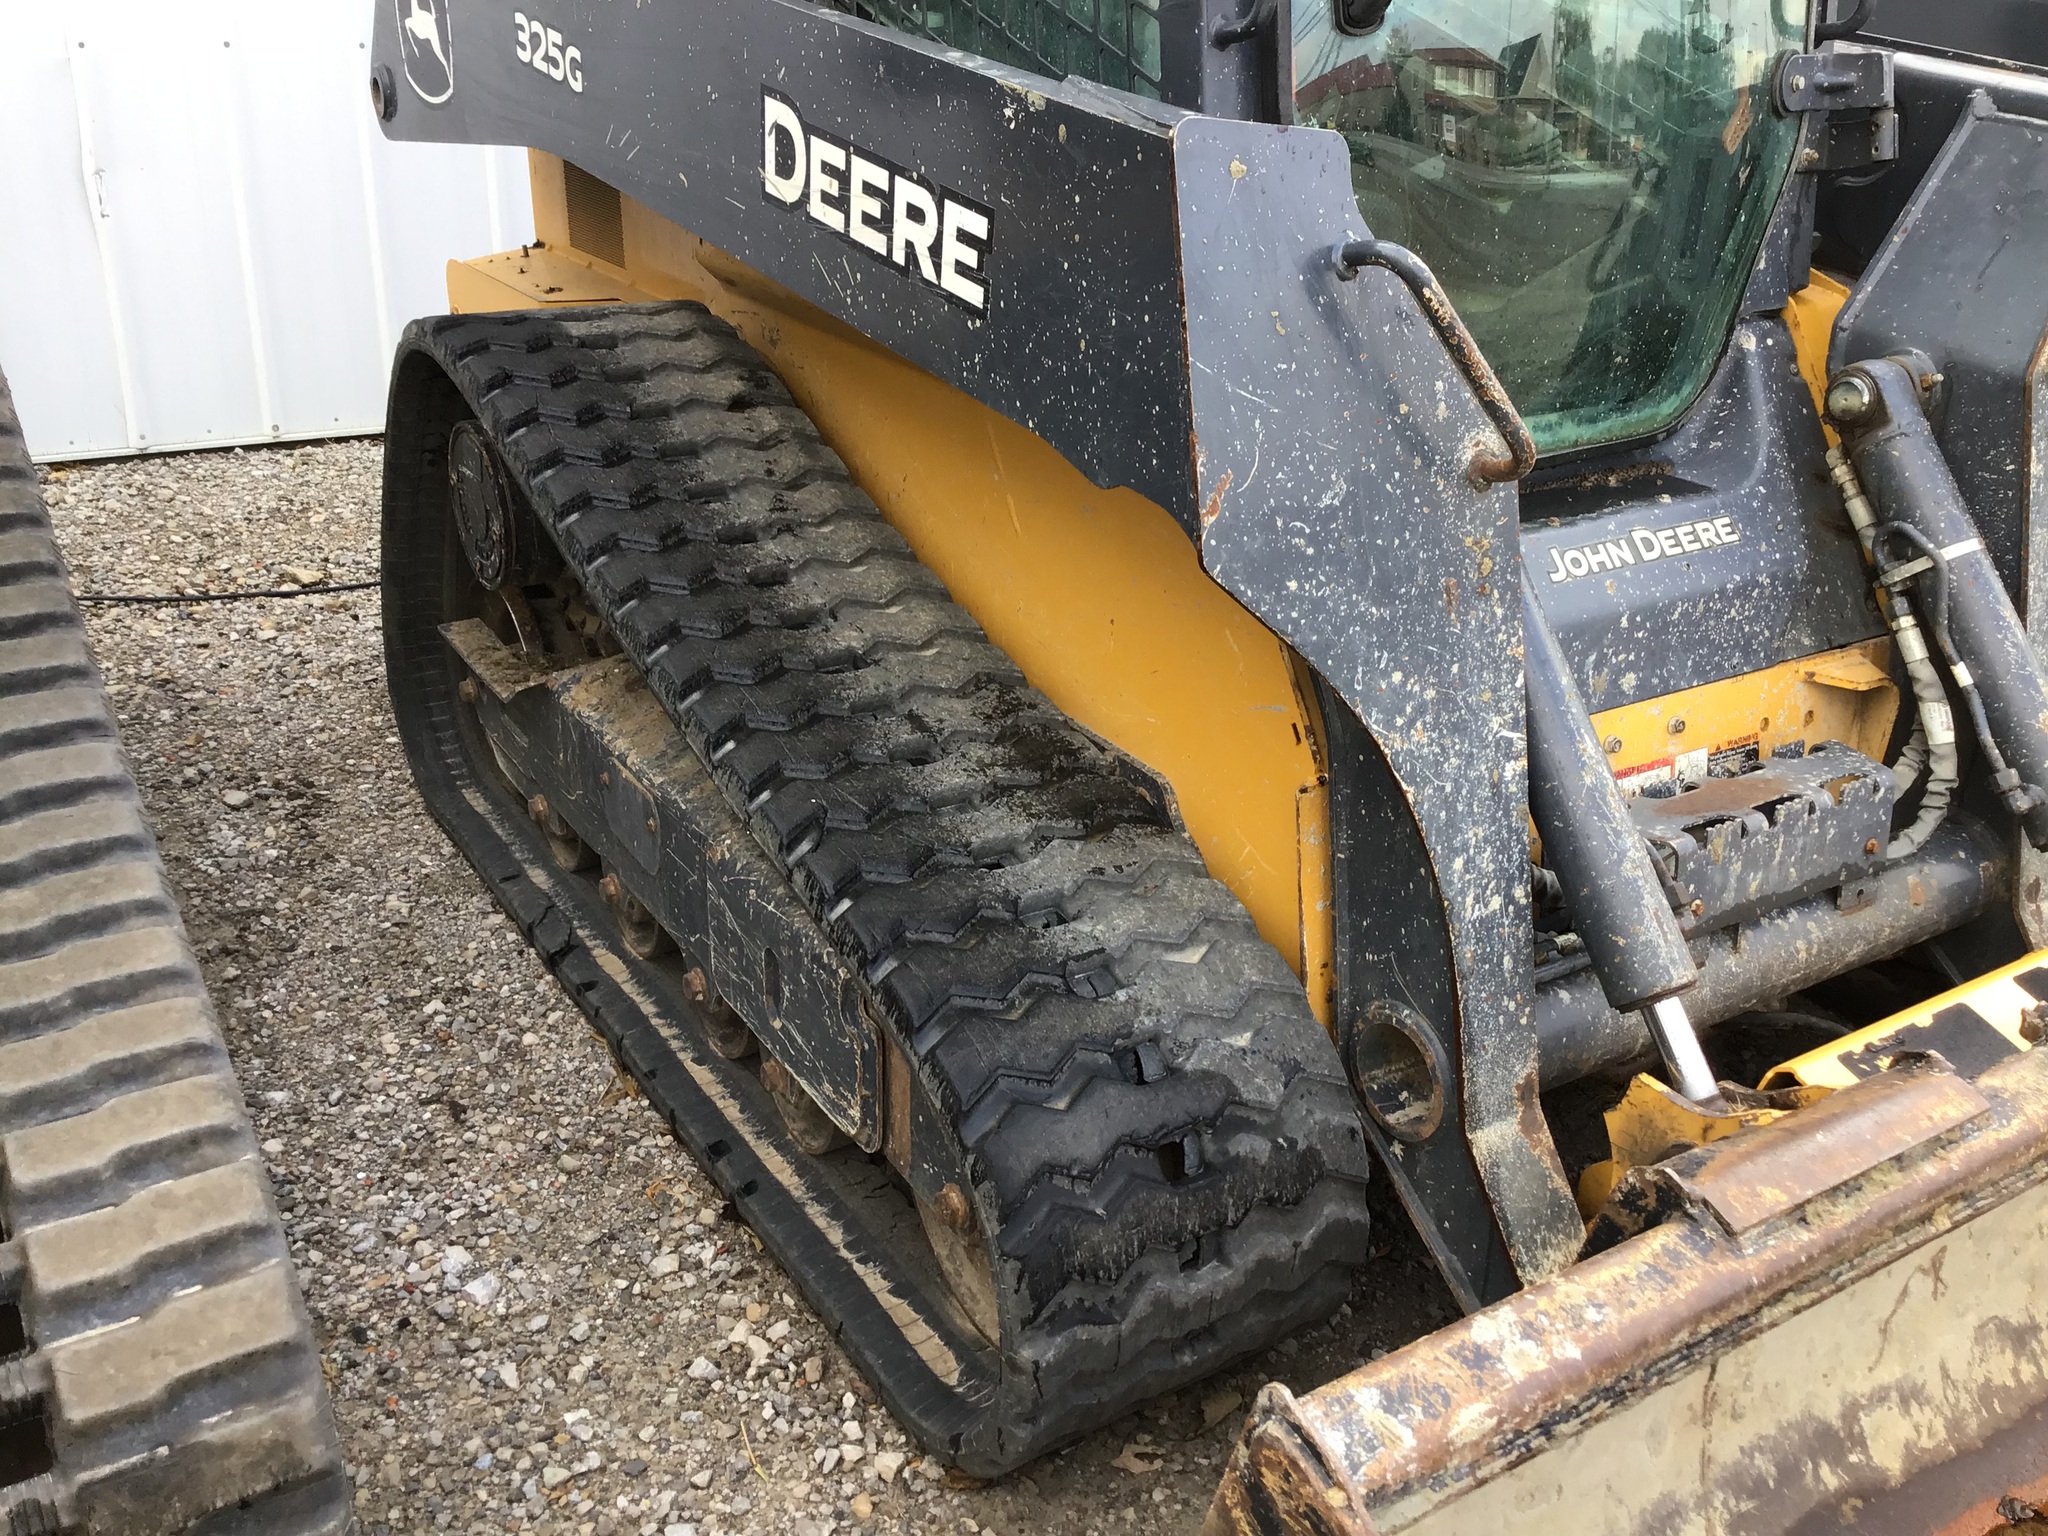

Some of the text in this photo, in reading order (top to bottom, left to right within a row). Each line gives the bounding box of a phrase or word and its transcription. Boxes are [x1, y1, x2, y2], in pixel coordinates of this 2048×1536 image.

[514, 12, 583, 93] 325G
[764, 95, 989, 309] DEERE
[1550, 516, 1741, 583] JOHN DEERE
